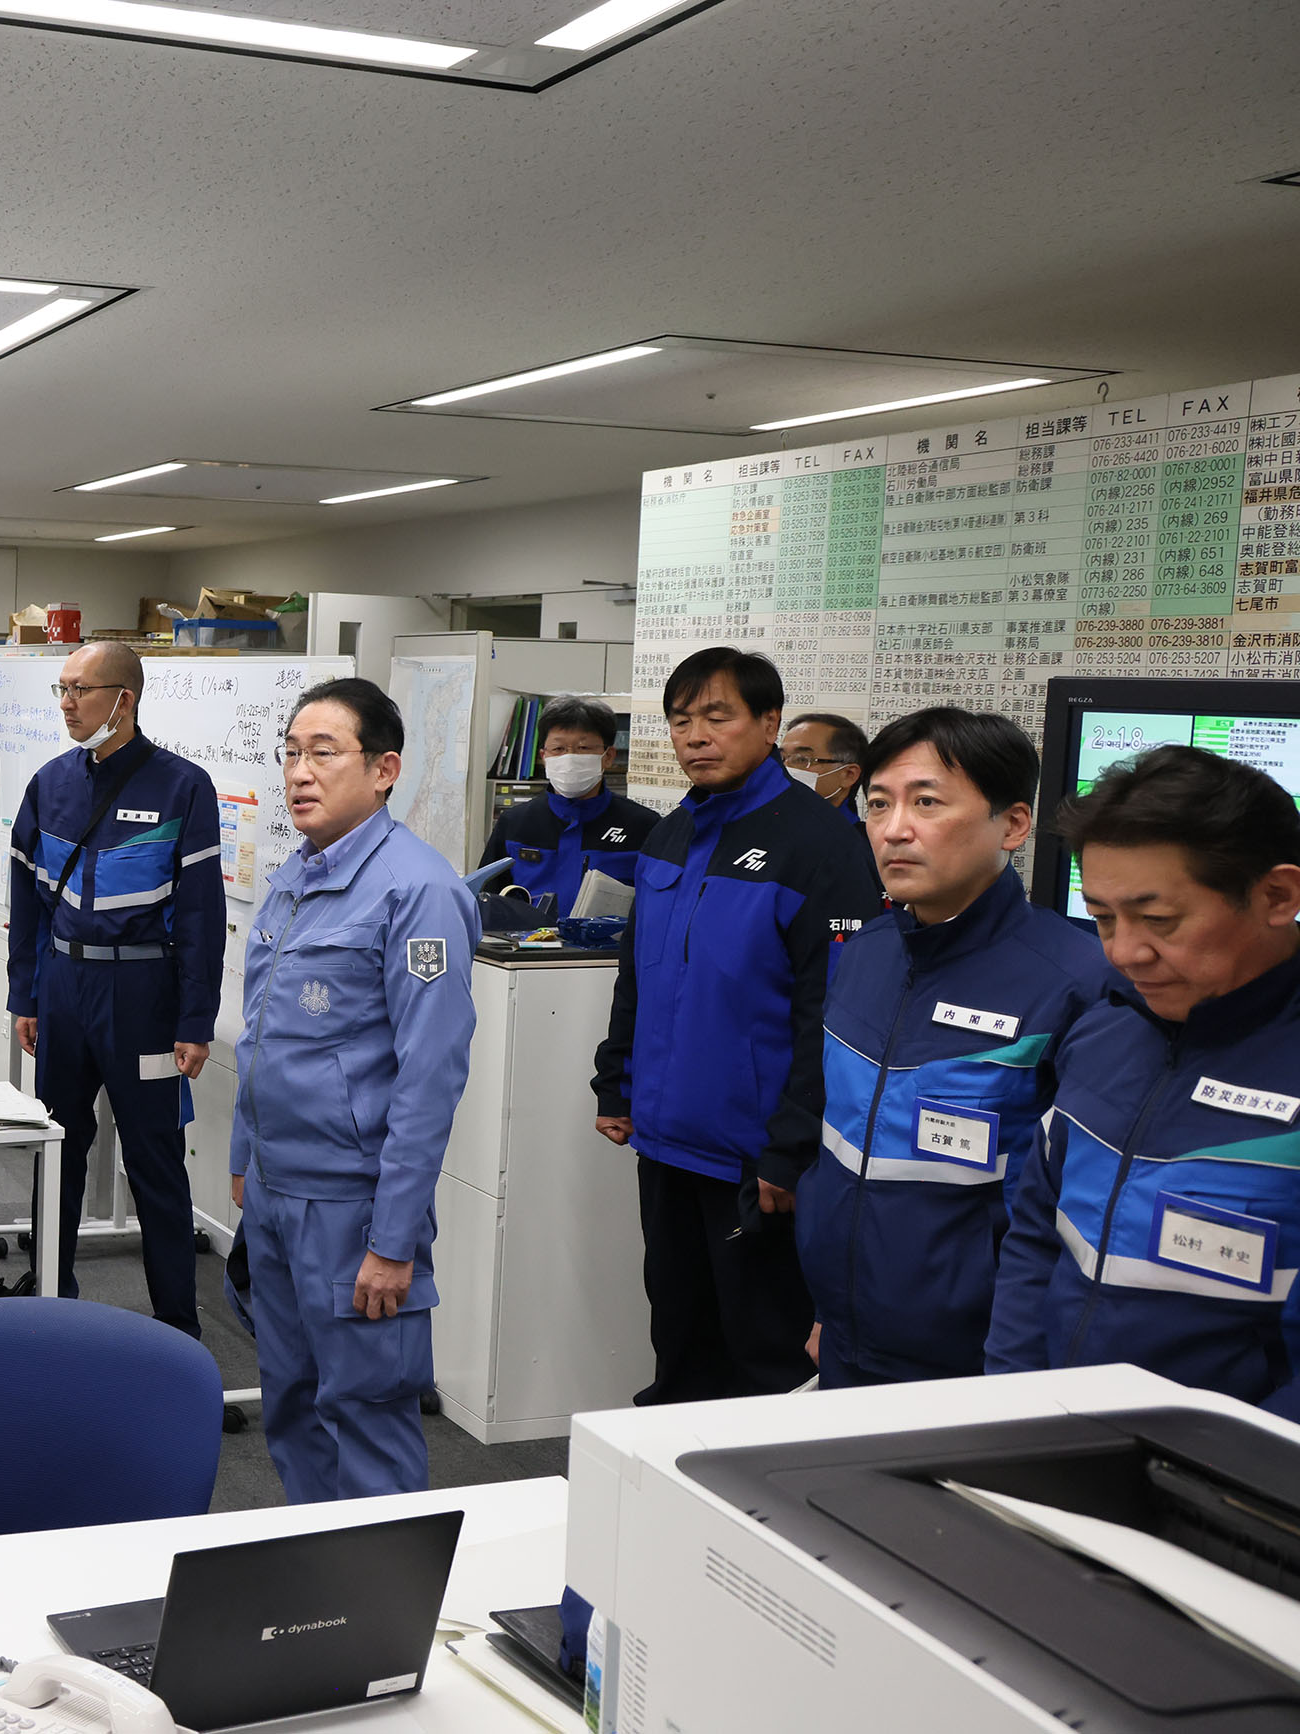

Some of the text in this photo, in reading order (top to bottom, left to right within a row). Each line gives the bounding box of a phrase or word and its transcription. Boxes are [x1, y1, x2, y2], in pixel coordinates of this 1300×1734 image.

[1182, 395, 1230, 417] FAX
[1108, 408, 1147, 426] TEL
[1025, 415, 1088, 440] 担当課等
[1167, 421, 1241, 442] 076-233-4419
[1093, 431, 1160, 452] 076-233-4411
[1166, 439, 1240, 460] 076-221-6020
[1018, 444, 1056, 462] 総務課
[1091, 449, 1159, 469] 076-265-4420
[738, 459, 781, 479] 担当課等
[887, 457, 961, 478] 北陸総合通信局
[1017, 461, 1055, 478] 総務課
[1164, 456, 1237, 477] 0767-82-0001
[886, 474, 938, 493] 石川労働局
[1091, 466, 1157, 485] 0767-82-0001
[733, 483, 759, 496] 防災課
[1015, 477, 1053, 494] 防衛課
[732, 494, 774, 510] 防災情報室
[885, 481, 1011, 507] 陸上自衛隊中部方面総監部
[1161, 492, 1234, 512] 076-241-2171
[731, 509, 771, 523] 救急企画室
[1087, 500, 1154, 518] 076-241-2171
[730, 522, 770, 537] 応急対策室
[781, 516, 827, 531] 03-5253-7527
[730, 534, 771, 548] 特殊災害室
[1084, 533, 1151, 551] 0761-22-2101
[1158, 528, 1231, 546] 0761-22-2101
[729, 549, 754, 562] 宿直室
[1010, 541, 1048, 556] 防衛班
[1009, 571, 1070, 588] 小松気象隊
[1236, 579, 1284, 595] 志賀町
[726, 586, 773, 600] 原子力防災課
[1081, 584, 1148, 600] 0773-62-2250
[1154, 581, 1227, 597] 0773-64-3609
[878, 590, 1003, 608] 海上自衛隊舞鶴地方総監部
[1235, 596, 1280, 612] 七尾市
[725, 614, 749, 626] 発電課
[1006, 619, 1067, 635] 事業推進課
[1075, 618, 1145, 633] 076-239-3880
[1150, 617, 1225, 631] 076-239-3881
[724, 626, 765, 639] 通信運用課
[877, 621, 993, 637] 日本赤十字社石川県支部
[875, 637, 955, 651] (社)石川県医師会
[1004, 636, 1040, 650] 事務局
[1074, 635, 1144, 649] 076-239-3800
[1148, 633, 1224, 648] 076-239-3810
[1002, 651, 1064, 666] 総務企画課
[1075, 651, 1141, 665] 076-253-5204
[1148, 651, 1221, 665] 076-253-5207
[1068, 696, 1093, 704] REGZA
[829, 919, 863, 932] 石川県
[943, 1009, 1006, 1031] 内閣府
[1201, 1084, 1291, 1114] 防災担当大臣
[931, 1132, 954, 1147] 古賀
[1172, 1231, 1204, 1252] 松村
[287, 1615, 349, 1635] dynabook
